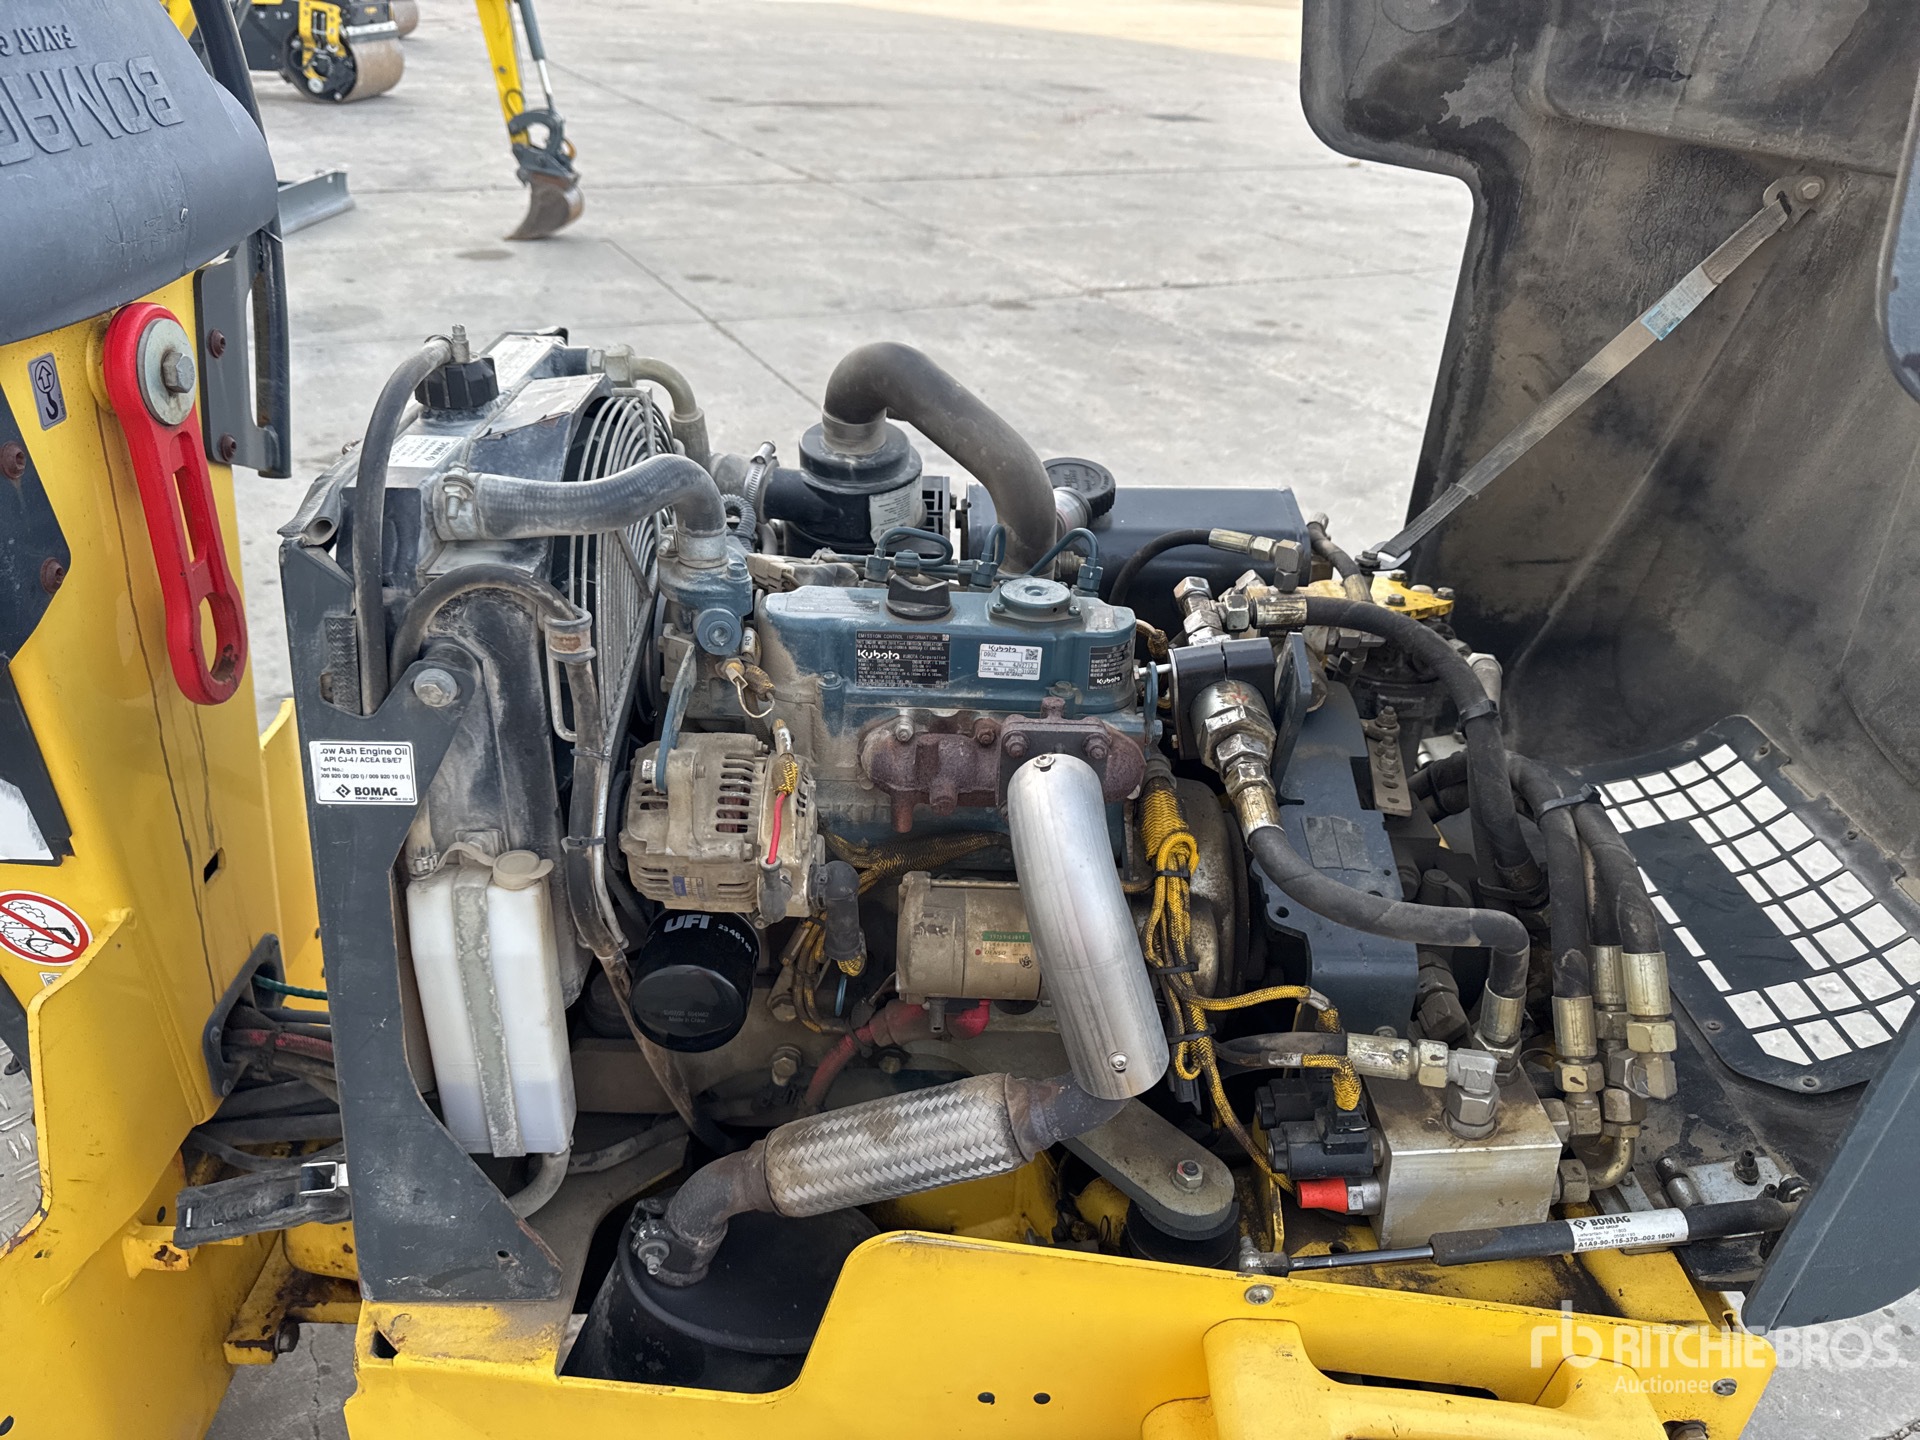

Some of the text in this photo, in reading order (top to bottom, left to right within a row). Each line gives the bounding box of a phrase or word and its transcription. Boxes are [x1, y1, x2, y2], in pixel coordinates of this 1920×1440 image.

[13, 24, 78, 54] FAYAT
[988, 645, 1016, 653] Kubota
[857, 649, 900, 660] Kubota
[1096, 676, 1120, 684] Kubota
[338, 746, 357, 755] Ash
[360, 747, 392, 756] Engine
[354, 786, 398, 796] BOMAG
[664, 914, 710, 933] UFI
[1589, 1216, 1631, 1226] BOMAG
